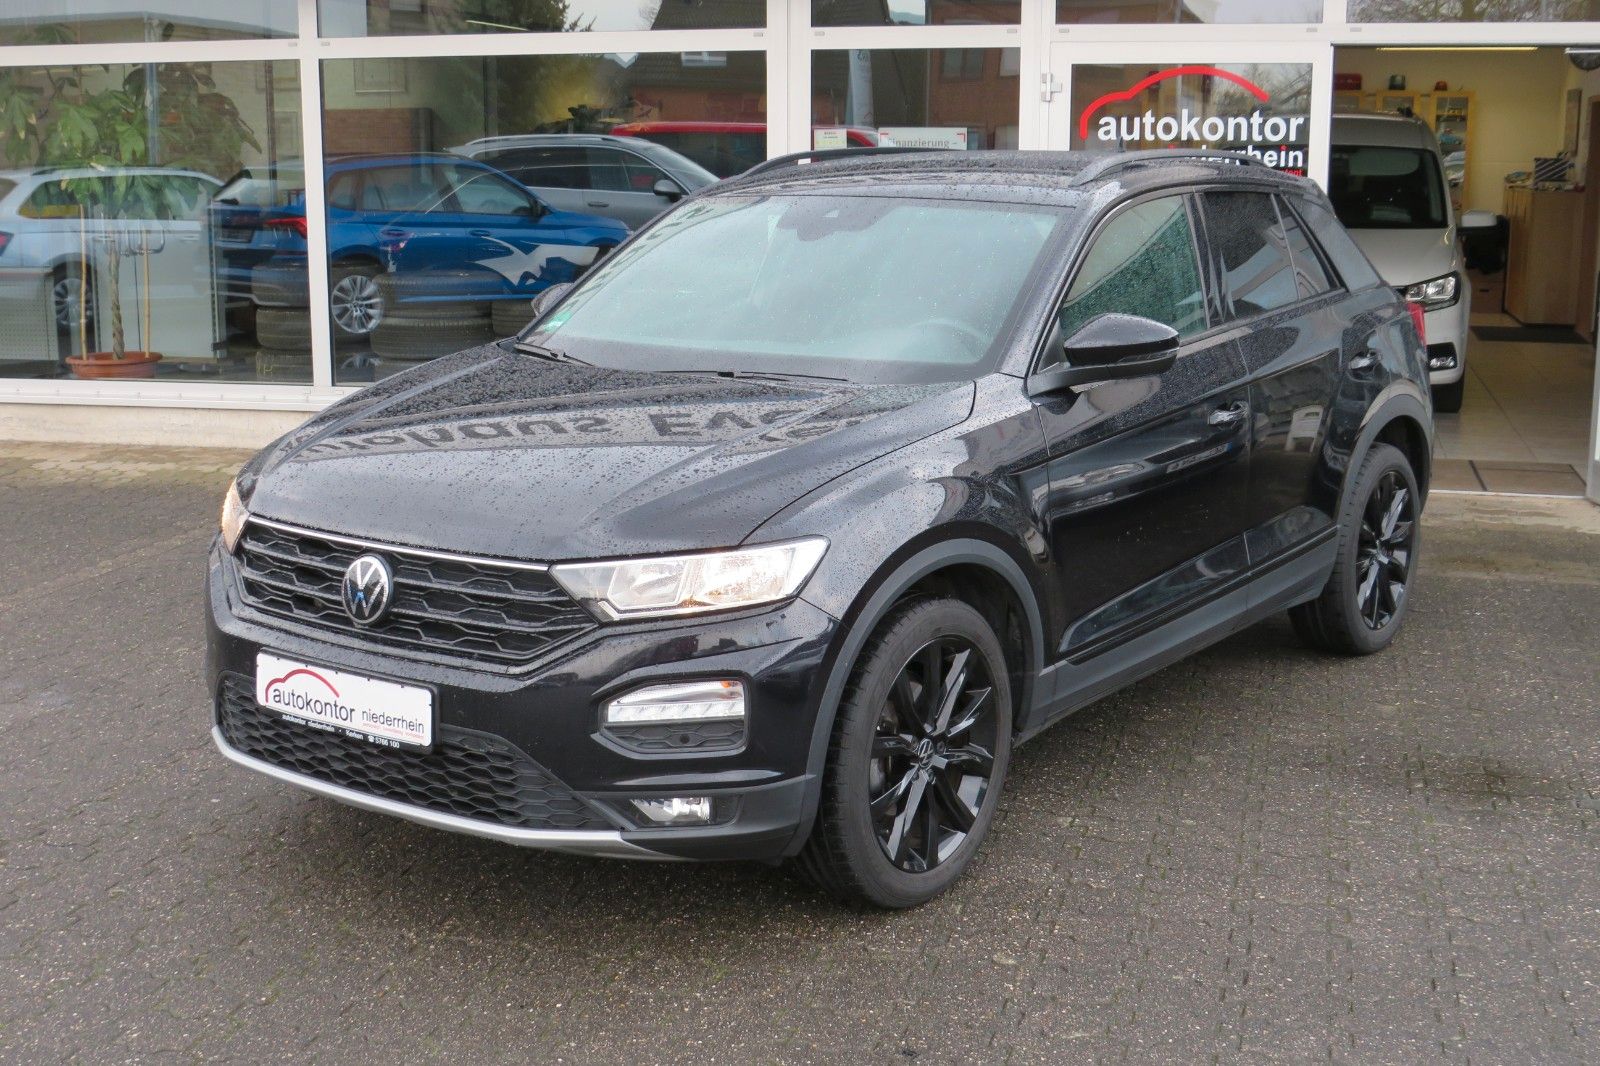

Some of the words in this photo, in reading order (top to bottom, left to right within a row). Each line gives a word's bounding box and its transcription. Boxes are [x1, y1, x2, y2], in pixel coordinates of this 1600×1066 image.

[1098, 108, 1305, 142] autokontor
[272, 687, 355, 723] autokontor
[361, 708, 425, 734] niederrhein
